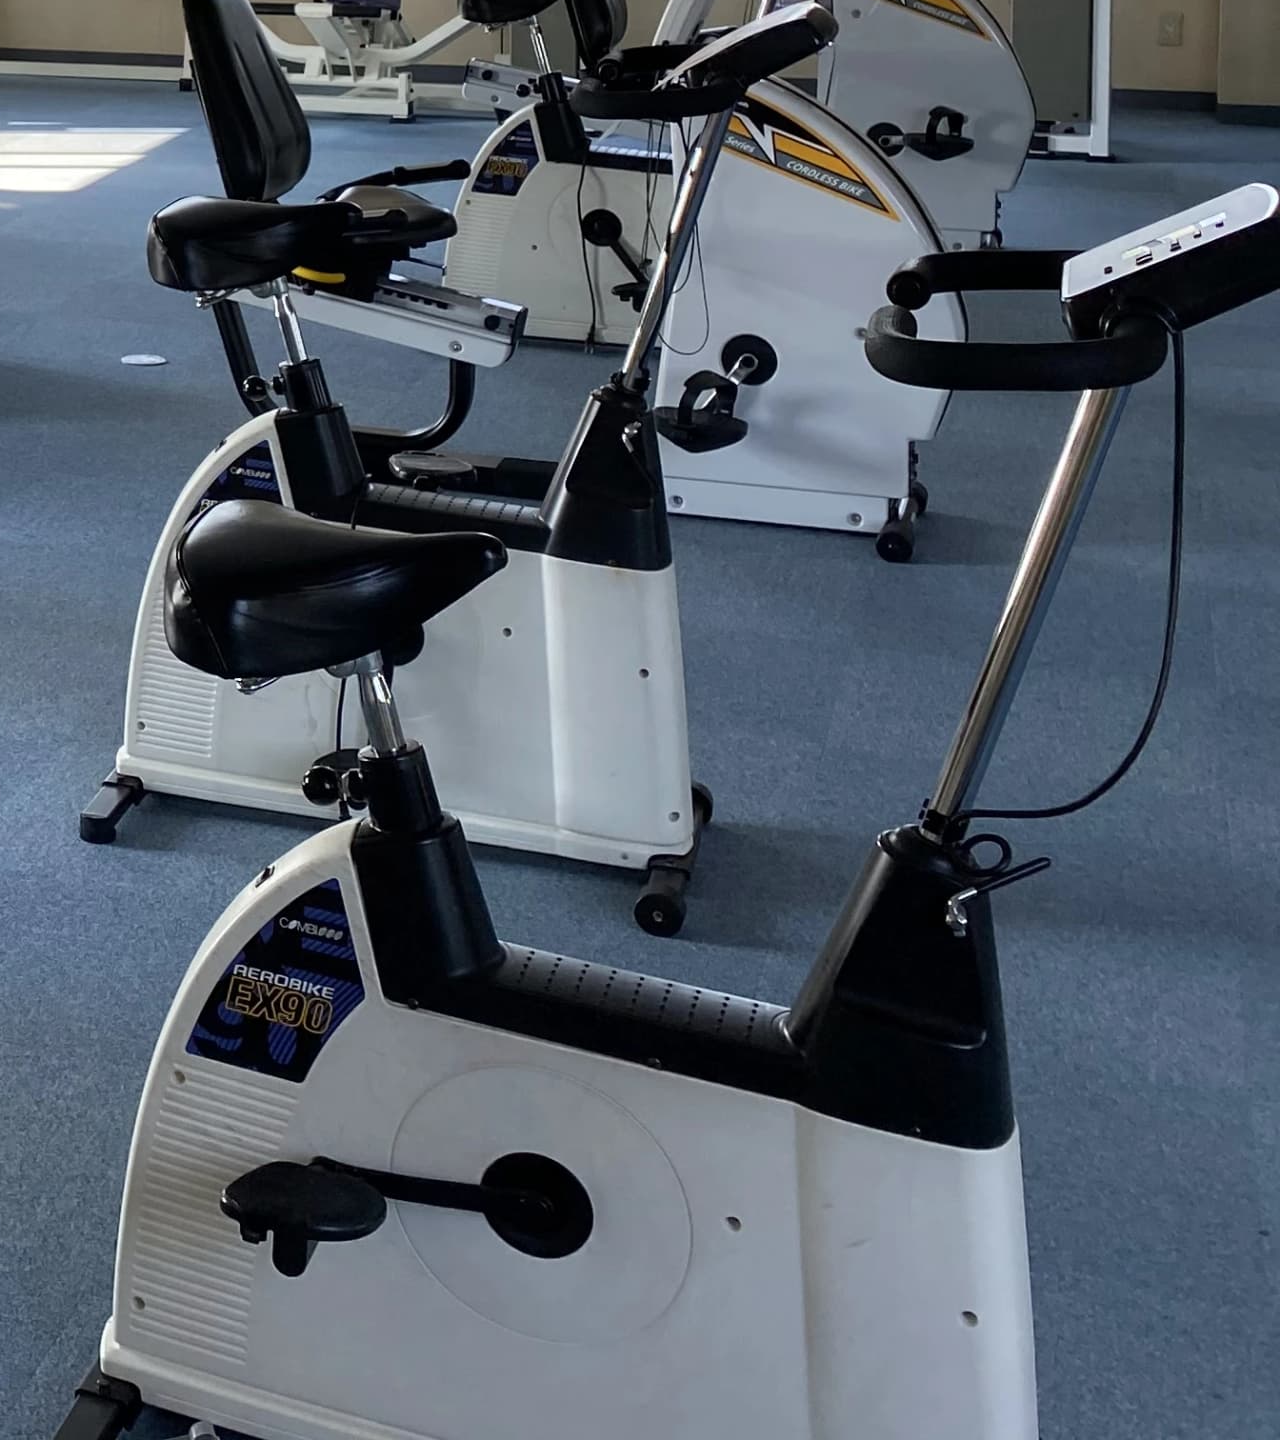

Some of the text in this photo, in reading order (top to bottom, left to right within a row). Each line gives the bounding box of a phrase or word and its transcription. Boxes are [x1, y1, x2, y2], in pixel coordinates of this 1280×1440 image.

[724, 135, 756, 154] Series
[786, 160, 865, 197] CORDLESS BIKE
[233, 964, 336, 1000] AEROBIKE
[224, 975, 333, 1035] EX90
